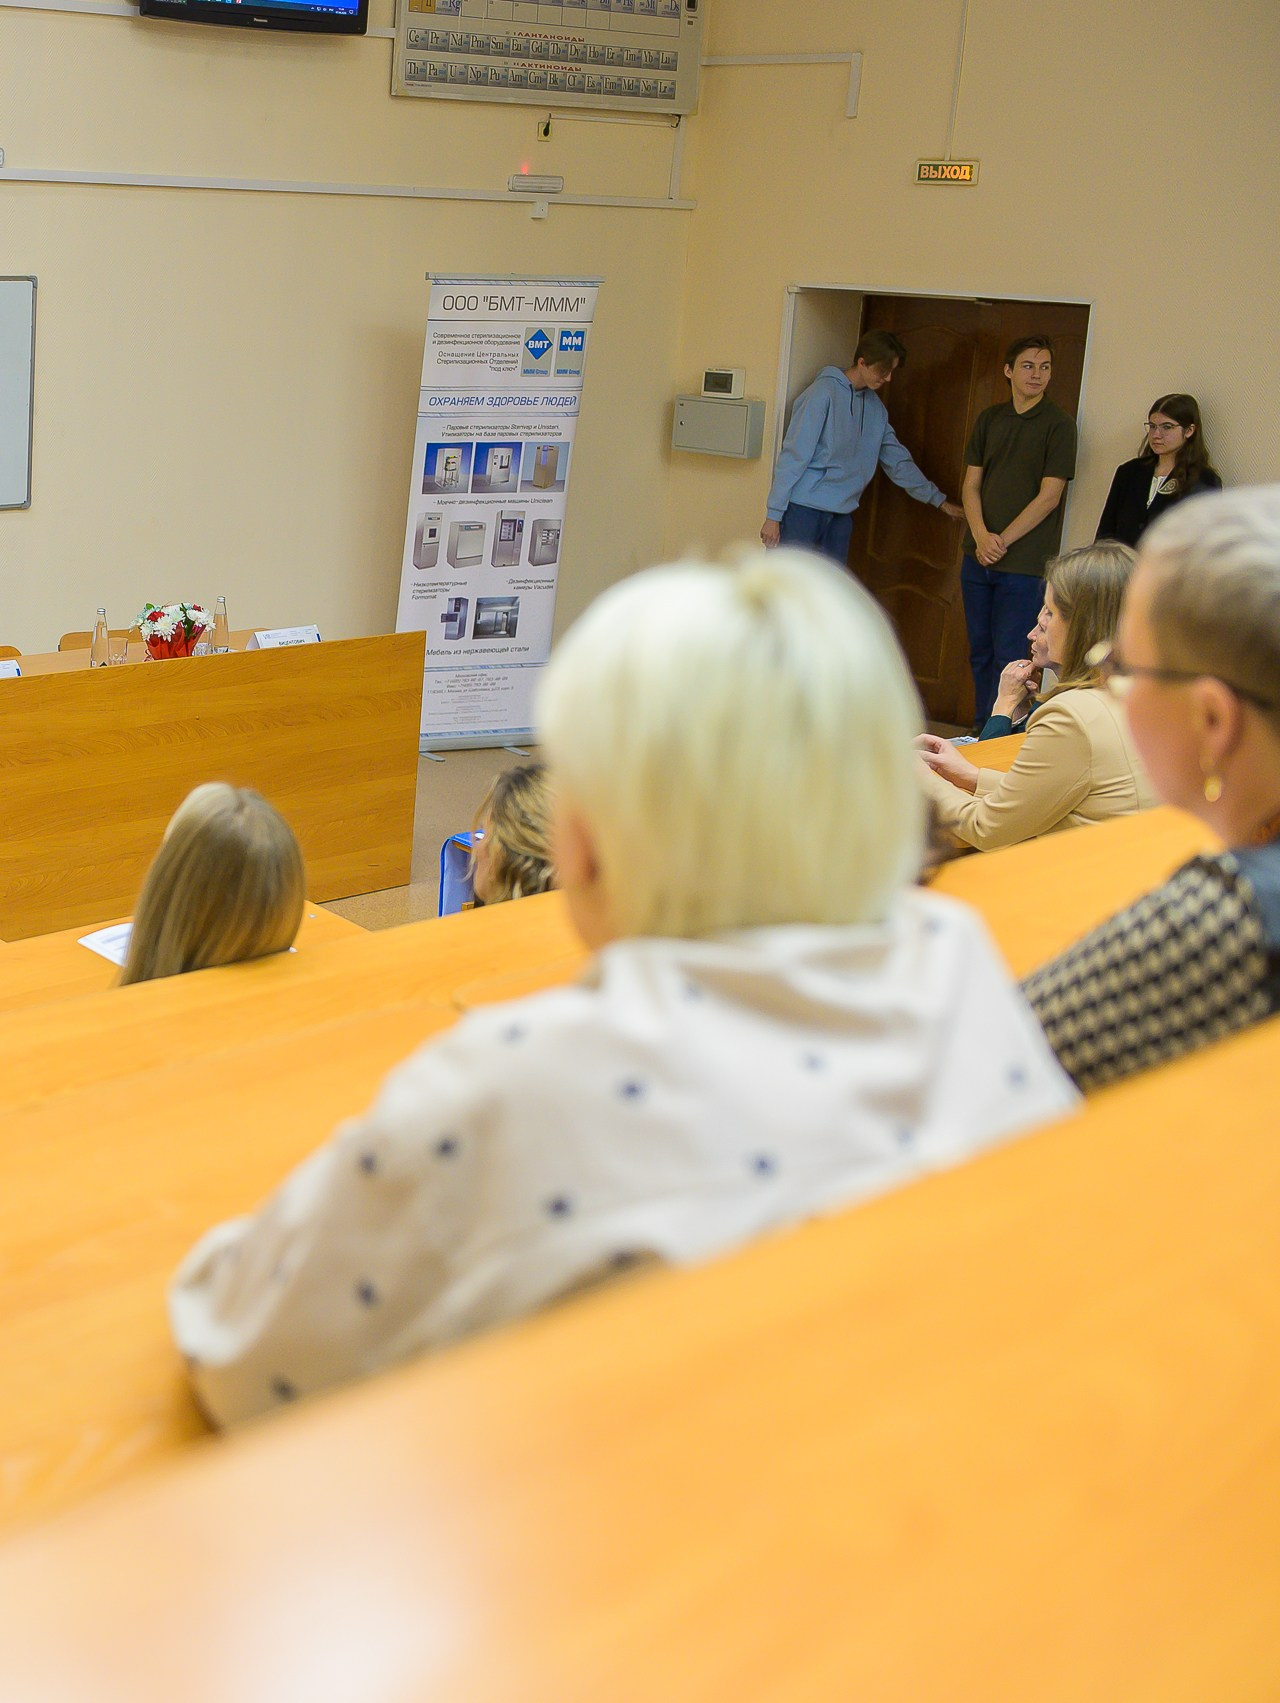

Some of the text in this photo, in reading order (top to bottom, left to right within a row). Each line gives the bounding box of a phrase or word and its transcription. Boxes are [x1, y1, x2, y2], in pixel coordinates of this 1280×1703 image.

[408, 29, 420, 43] Ce
[430, 32, 440, 44] Pr
[450, 33, 463, 46] Nd
[471, 35, 485, 49] Pm
[491, 37, 504, 49] Sm
[531, 40, 543, 53] Gd
[550, 43, 561, 55] Tb
[588, 46, 599, 58] Ho
[606, 48, 615, 60] Er
[625, 49, 636, 61] Tm
[643, 51, 654, 63] Yb
[661, 53, 671, 64] Lu
[407, 61, 419, 75] Th
[428, 63, 438, 76] Pa
[449, 65, 457, 78] U
[470, 66, 482, 81] Np
[489, 68, 500, 81] Pu
[508, 70, 523, 82] Am
[528, 71, 542, 84] Cm
[548, 73, 559, 85] Bk
[586, 76, 595, 88] Es
[604, 77, 617, 90] Fm
[622, 79, 634, 91] Md
[641, 80, 652, 92] No
[659, 82, 668, 93] Lr
[920, 165, 970, 180] ВЫХОД
[442, 295, 586, 312] ООО "БМТ-МММ"
[428, 395, 577, 407] ОХРАНЯЕМ ЗДОРОВЬЕ ЛЮДЕЙ
[462, 646, 509, 656] нержавеющей
